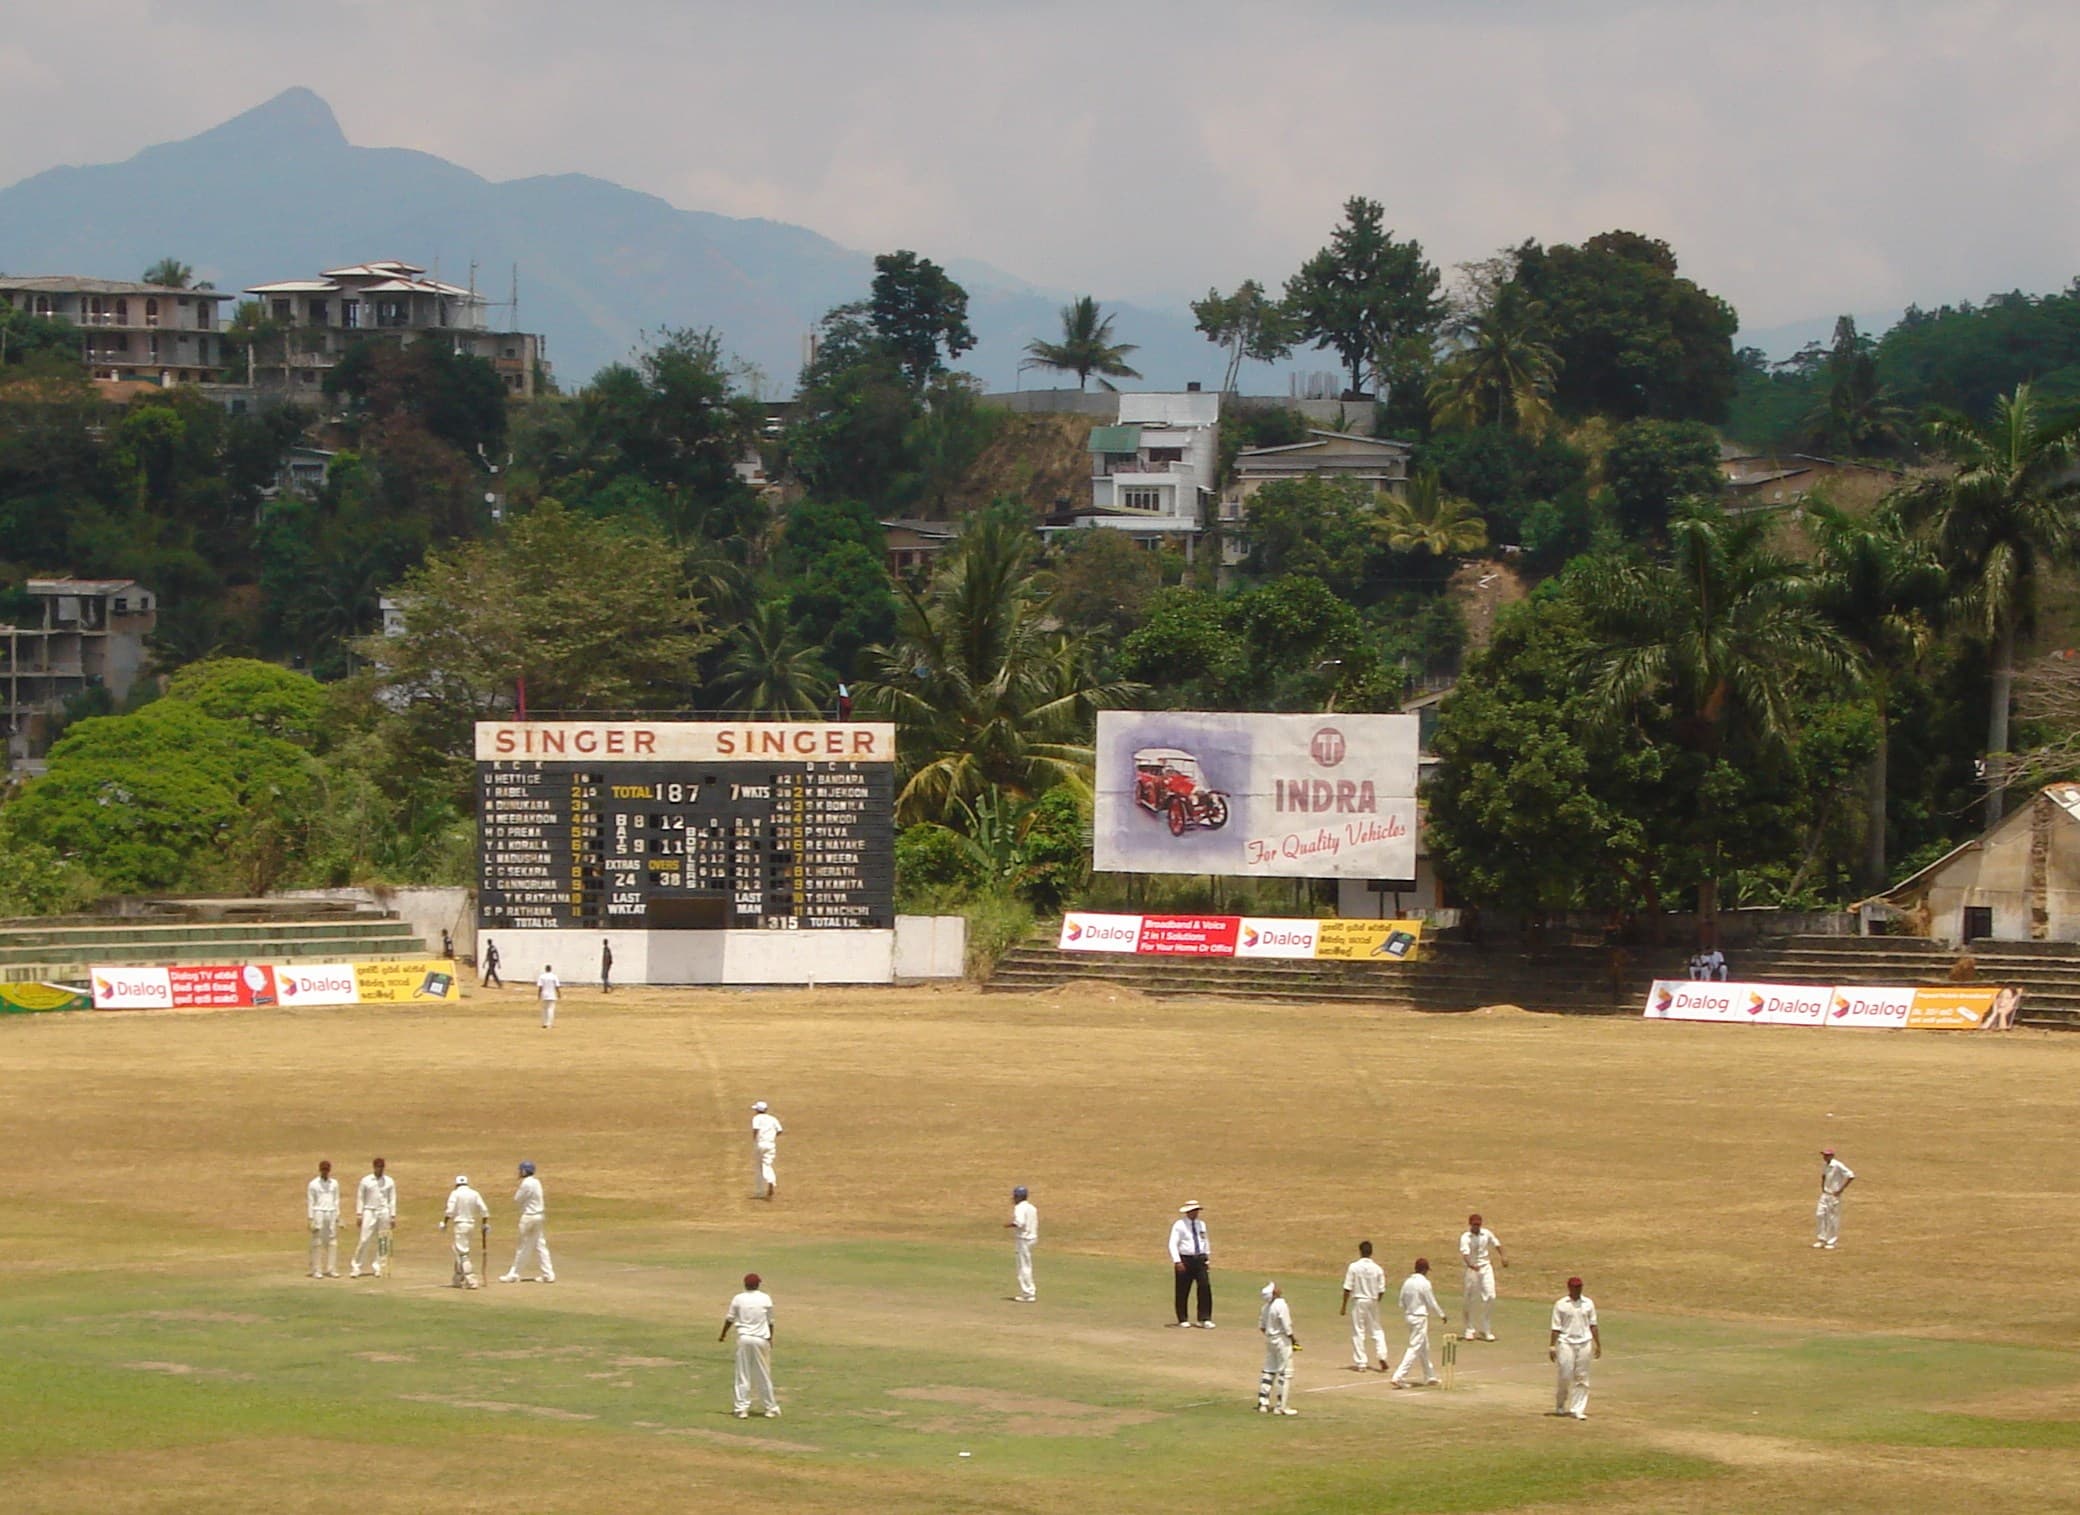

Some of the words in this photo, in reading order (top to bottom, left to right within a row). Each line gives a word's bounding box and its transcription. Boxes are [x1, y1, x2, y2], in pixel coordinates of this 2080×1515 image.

[496, 730, 656, 753] SINGER
[717, 731, 875, 754] SINGER
[513, 761, 520, 770] C
[828, 762, 836, 771] C
[484, 774, 492, 784] U
[806, 775, 814, 784] Y
[571, 787, 581, 797] 2
[611, 786, 653, 799] TOTAL
[655, 784, 699, 803] 187
[741, 786, 770, 799] WKTS
[793, 787, 804, 797] 2
[1276, 779, 1376, 813] INDRA
[571, 801, 581, 811] 3
[793, 801, 804, 811] 3
[571, 814, 581, 824] 4
[634, 815, 644, 828] 8
[661, 816, 684, 830] 12
[752, 818, 761, 828] W
[793, 814, 804, 823] 4
[806, 814, 813, 823] S
[571, 827, 581, 838] 5
[615, 814, 628, 855] BATS
[794, 827, 803, 837] 5
[805, 827, 812, 837] P
[815, 827, 848, 837] SILVA
[1248, 841, 1276, 864] For
[1282, 829, 1340, 859] Quality
[1346, 815, 1406, 846] Vehicles
[485, 841, 492, 850] Y
[497, 841, 504, 850] A
[571, 841, 581, 850] 6
[634, 839, 644, 853] 9
[661, 840, 684, 855] 11
[793, 840, 804, 850] 6
[816, 840, 824, 850] E
[485, 854, 492, 864] L
[572, 854, 581, 864] 7
[795, 854, 804, 863] 7
[605, 860, 641, 870] EXTRAS
[485, 867, 492, 876] C
[571, 867, 581, 876] 8
[794, 867, 804, 877] 8
[806, 867, 812, 877] L
[485, 880, 492, 890] L
[571, 880, 581, 890] 9
[615, 873, 636, 887] 24
[660, 873, 681, 887] 38
[794, 880, 804, 890] 9
[806, 880, 813, 890] S
[504, 893, 511, 903] T
[514, 893, 522, 903] K
[612, 893, 641, 903] LAST
[735, 893, 763, 903] LAST
[806, 893, 813, 903] T
[816, 893, 848, 903] SILVA
[484, 907, 491, 917] S
[495, 907, 503, 917] P
[736, 904, 762, 914] MAN
[514, 918, 542, 928] TOTAL
[768, 917, 799, 930] 315
[811, 918, 841, 928] TOTAL
[1145, 920, 1193, 930] Broadband
[1202, 921, 1226, 930] Voice
[1086, 925, 1135, 944] Dialog
[1143, 932, 1150, 941] 2
[1166, 933, 1206, 943] Solutions
[1262, 930, 1313, 949] Dialog
[1140, 944, 1154, 952] For
[1155, 944, 1174, 952] Your
[1174, 945, 1198, 953] Home
[1198, 945, 1209, 953] Or
[1209, 945, 1233, 954] Office
[198, 971, 213, 981] TV
[116, 981, 167, 1000] Dialog
[300, 977, 352, 994] Dialog
[1676, 994, 1730, 1014] Dialog
[1767, 997, 1822, 1017] Dialog
[1852, 1000, 1907, 1020] Dialog
